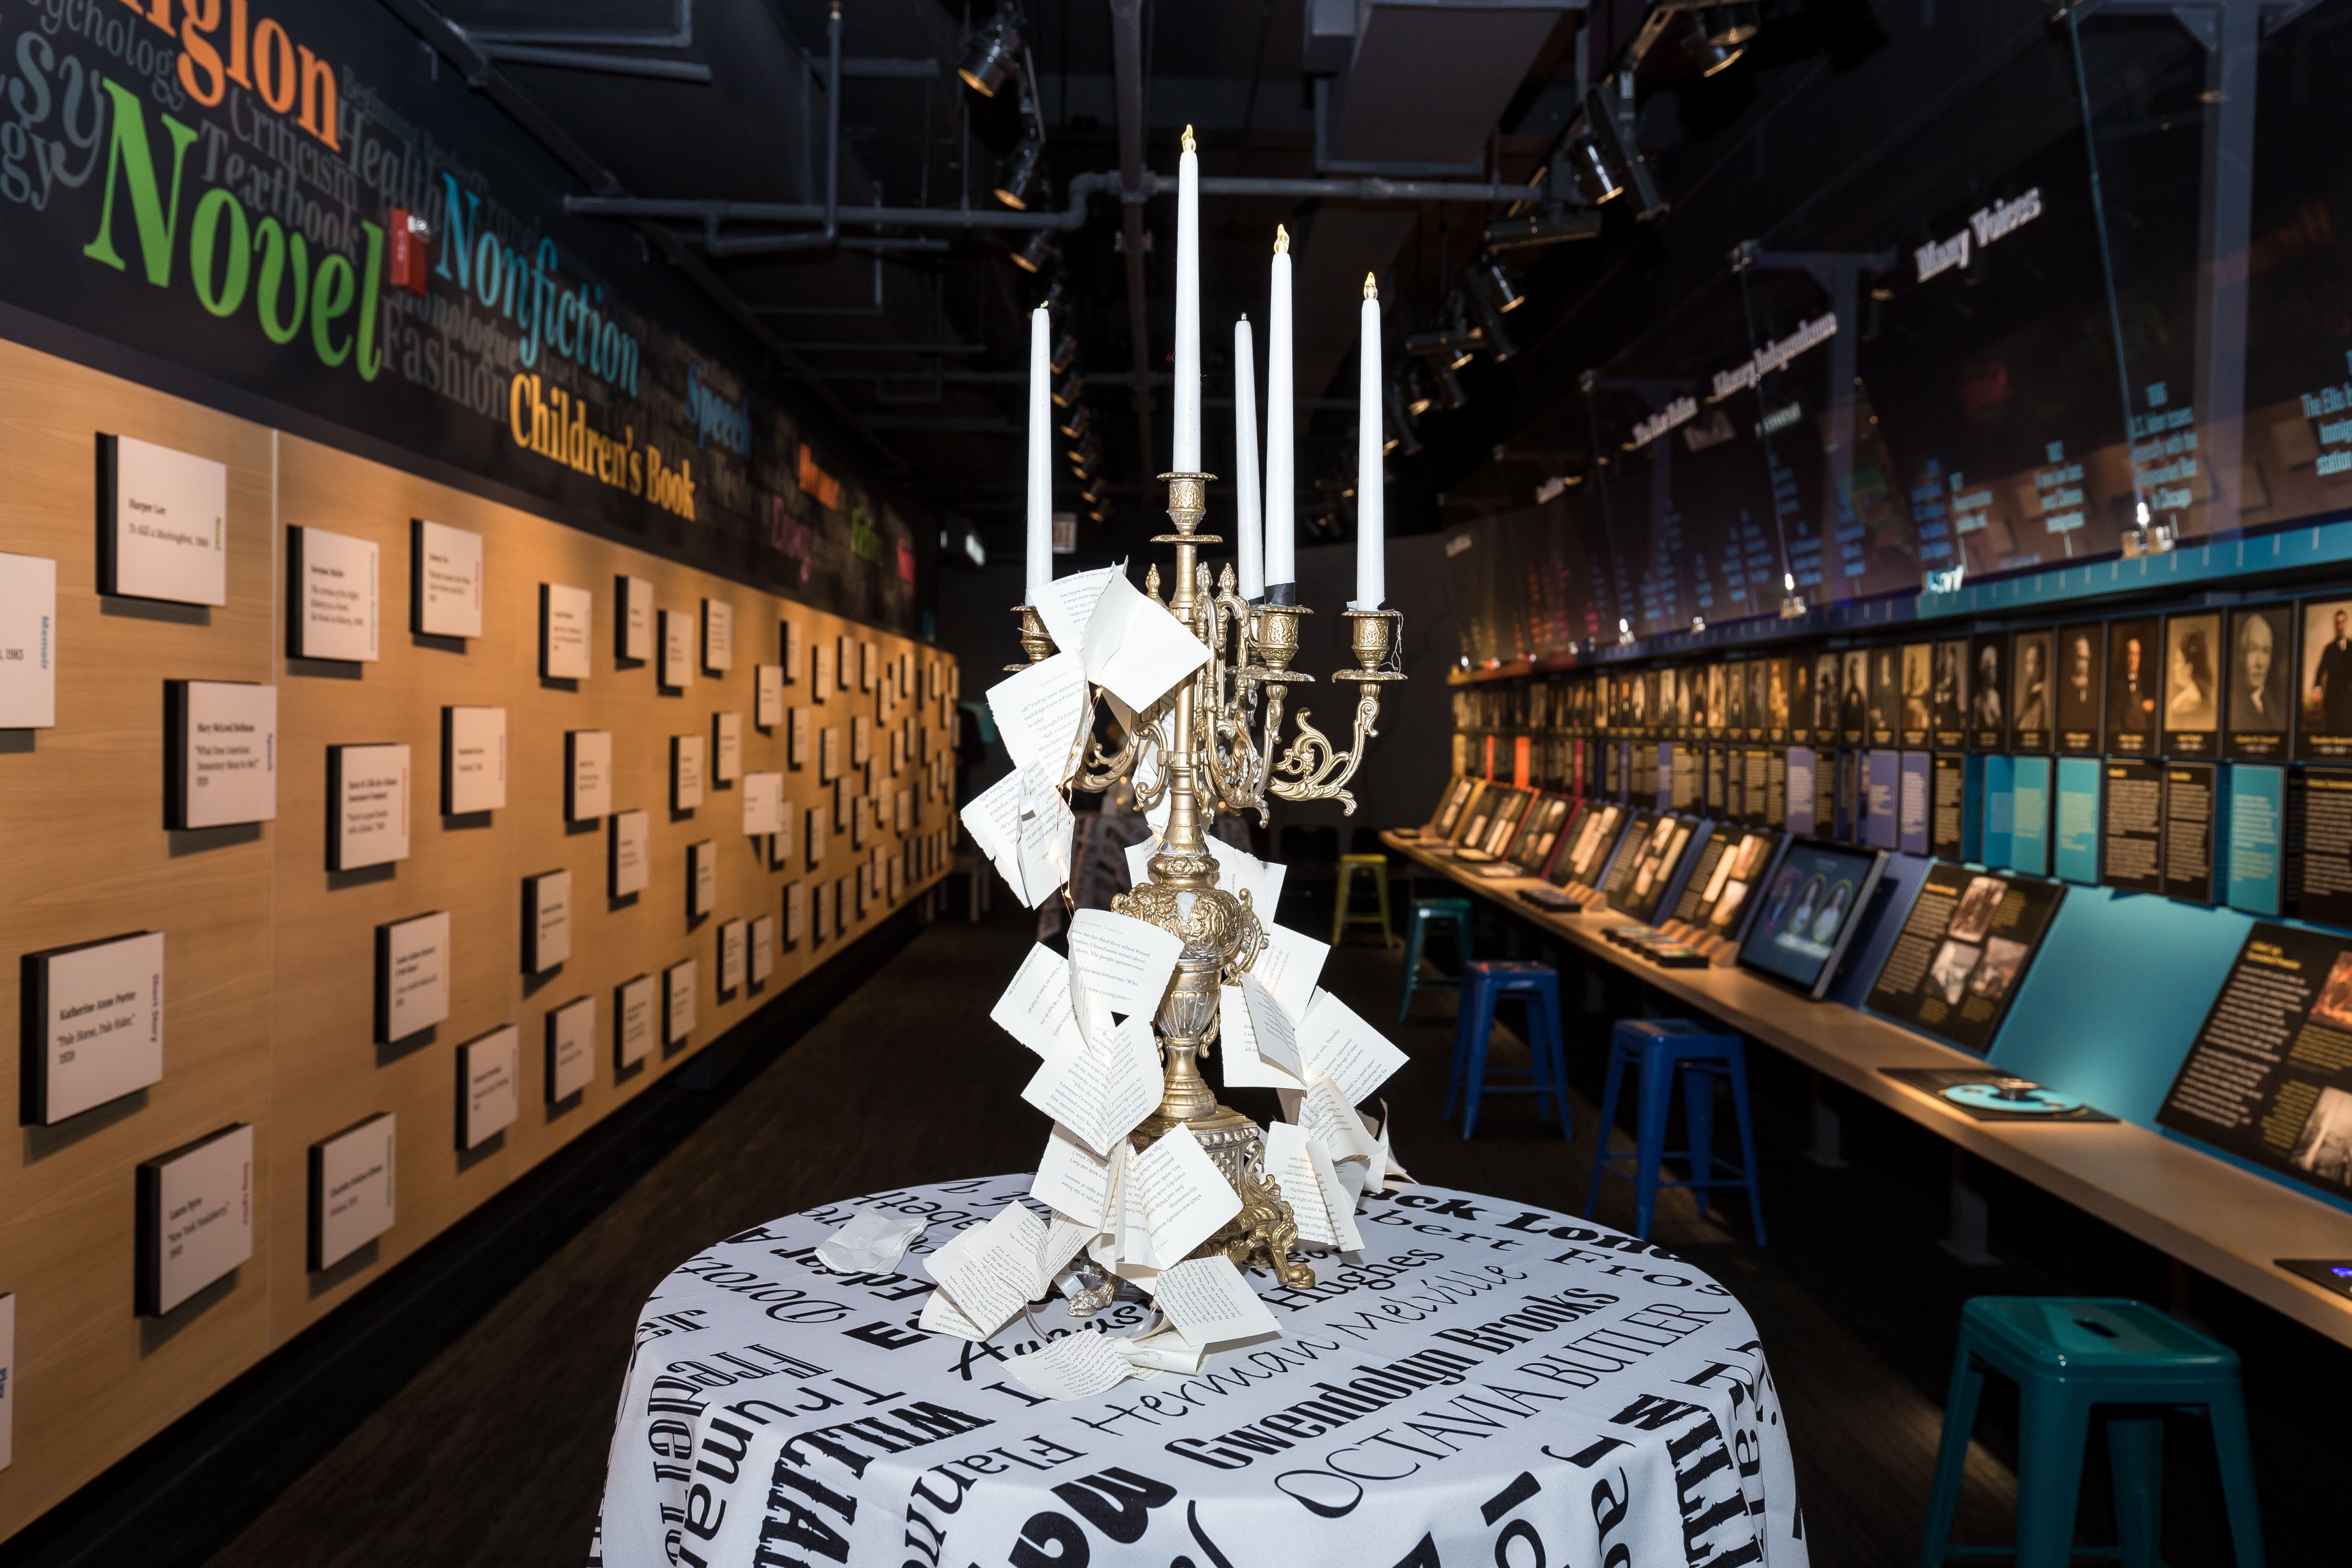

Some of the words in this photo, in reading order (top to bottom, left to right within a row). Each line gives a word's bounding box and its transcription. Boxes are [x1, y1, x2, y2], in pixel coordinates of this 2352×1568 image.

[229, 87, 358, 213] Criticism
[338, 95, 442, 232] Health
[200, 119, 359, 265] Textbook
[83, 77, 384, 382] Novel
[1914, 228, 1971, 283] Many
[1969, 186, 2042, 248] Voices
[435, 172, 639, 397] Nonfiction
[381, 294, 508, 426] Fashion
[510, 373, 643, 497] Children's
[646, 444, 696, 522] Book
[1024, 712, 1035, 721] reach
[1034, 706, 1047, 715] Ralph
[1046, 701, 1058, 709] Curtis
[1062, 691, 1077, 700] Palazzo
[1038, 744, 1051, 752] Henry
[1050, 737, 1062, 746] James
[1093, 943, 1106, 951] heard
[1132, 956, 1146, 965] above,
[1135, 949, 1150, 957] Pound
[1311, 1052, 1320, 1062] legal
[1319, 1045, 1328, 1053] wife,
[1326, 1029, 1340, 1044] Dorothy
[1323, 1057, 1337, 1071] become
[1336, 1038, 1353, 1057] expatriates
[1344, 1049, 1365, 1069] Youngstown,
[1068, 1068, 1084, 1081] painted
[1361, 1069, 1378, 1087] publishing
[1055, 1088, 1077, 1106] understand
[1080, 1107, 1091, 1116] word
[1060, 1081, 1079, 1097] Lawrence
[1078, 1095, 1095, 1110] Gowing.
[1059, 1101, 1075, 1115] upstairs
[1076, 1114, 1085, 1122] with
[1152, 1143, 1164, 1152] Olga,
[1156, 1187, 1167, 1196] took
[1167, 1192, 1175, 1201] and
[1175, 1183, 1185, 1193] Jane
[1155, 1198, 1168, 1208] Philip
[1169, 1191, 1190, 1209] reassuring.
[1189, 1194, 1202, 1205] which
[1166, 1209, 1183, 1223] virtually
[1154, 1221, 1167, 1235] around
[1354, 1207, 1524, 1251] bert
[1543, 1247, 1732, 1296] Fros
[666, 1255, 857, 1325] Dorot
[944, 1280, 965, 1299] American.
[964, 1264, 975, 1277] expert.
[981, 1284, 990, 1295] often
[964, 1283, 972, 1291] told
[1258, 1248, 1444, 1312] Hughes
[954, 1285, 977, 1306] Collection.
[995, 1292, 1009, 1301] adviser
[1194, 1305, 1203, 1314] must
[1202, 1314, 1210, 1323] fight
[1071, 1340, 1340, 1436] Herman
[1325, 1265, 1527, 1340] Melville
[1164, 1348, 1484, 1469] Gwendolyn
[1430, 1287, 1620, 1355] Brooks
[1274, 1383, 1568, 1518] OCTAVIA
[1514, 1303, 1732, 1389] BUTLER
